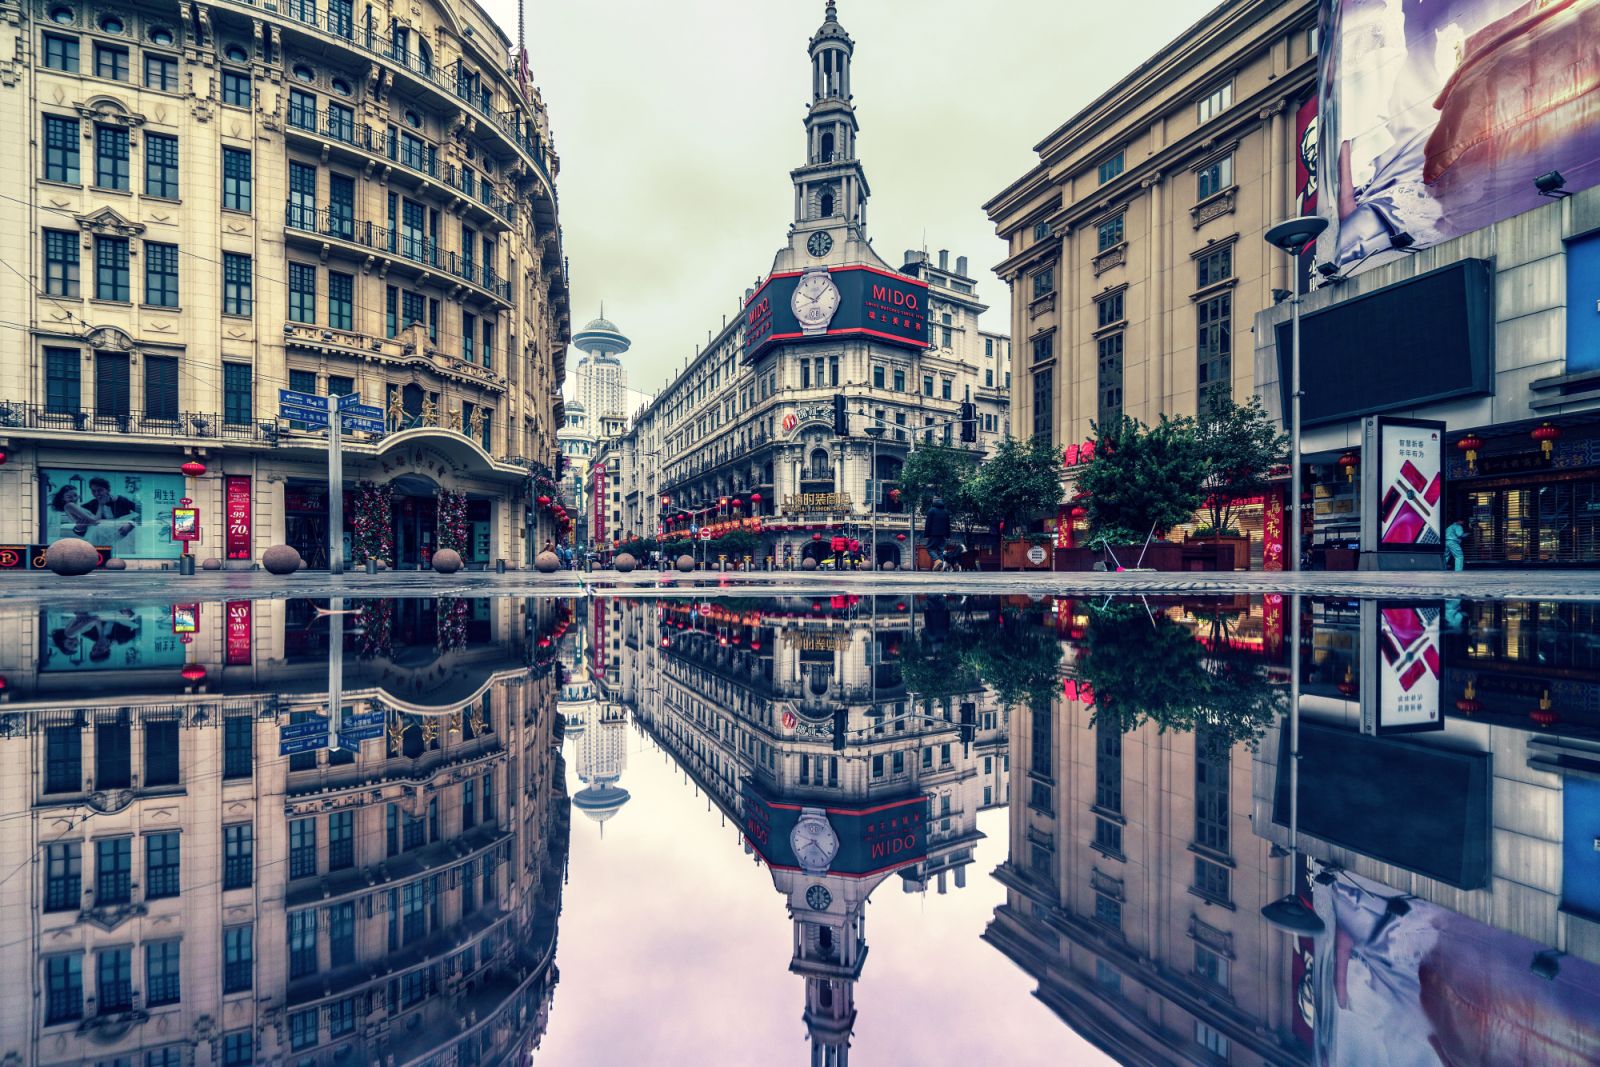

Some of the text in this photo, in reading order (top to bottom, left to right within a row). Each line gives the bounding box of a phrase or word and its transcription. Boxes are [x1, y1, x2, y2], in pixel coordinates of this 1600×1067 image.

[872, 284, 917, 309] MIDO
[749, 297, 769, 325] MIDO
[797, 404, 835, 420] 锦江之
[154, 488, 176, 501] 周生生
